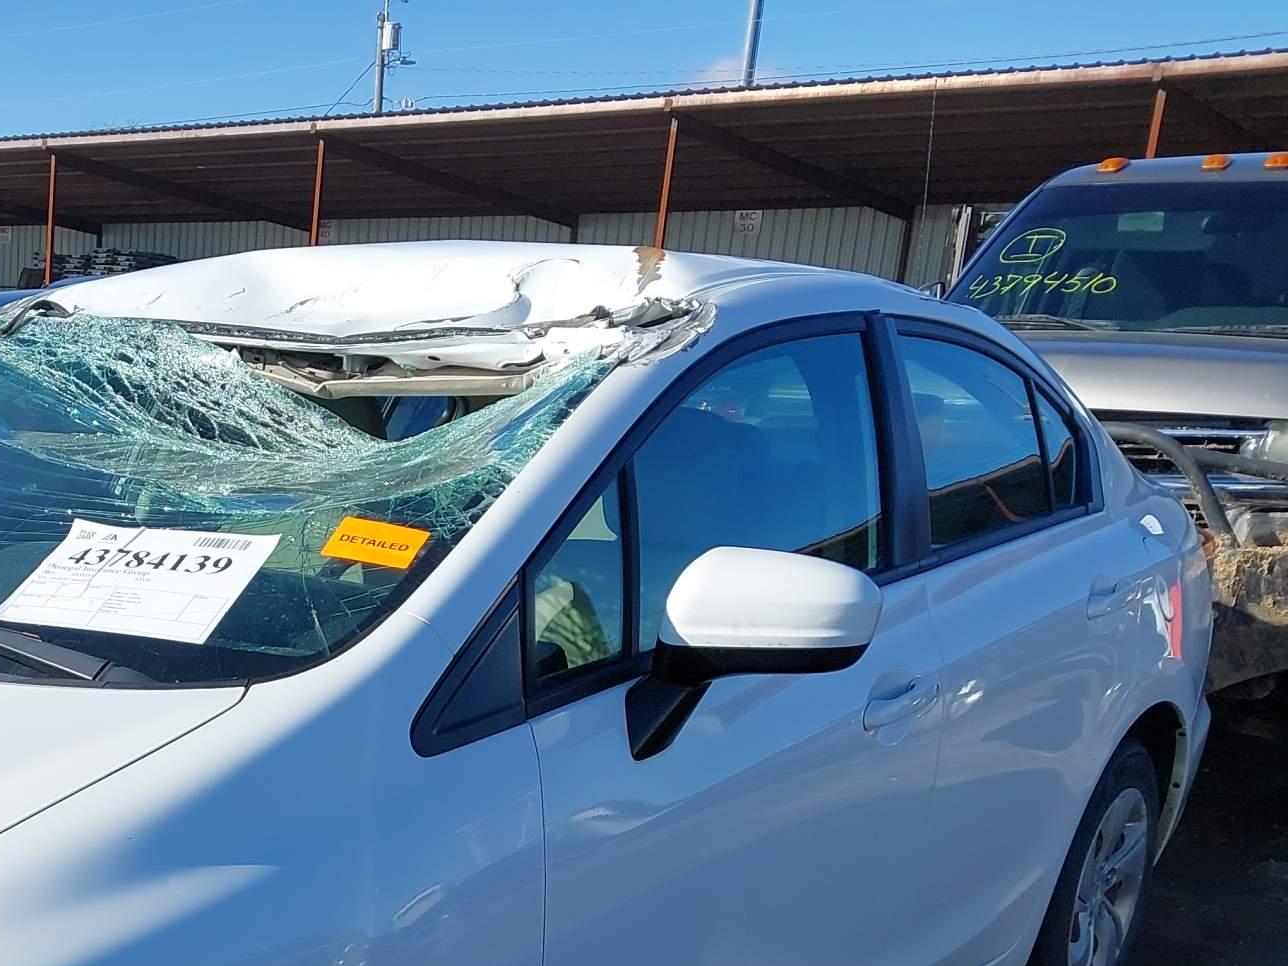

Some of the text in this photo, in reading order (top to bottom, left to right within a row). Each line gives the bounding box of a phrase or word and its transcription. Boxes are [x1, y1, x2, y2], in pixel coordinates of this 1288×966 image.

[739, 211, 758, 221] MC
[739, 223, 754, 233] 30
[969, 271, 1117, 299] 43794510
[339, 533, 410, 552] DETAILED
[68, 547, 233, 575] 43784139
[83, 564, 122, 575] Insuance
